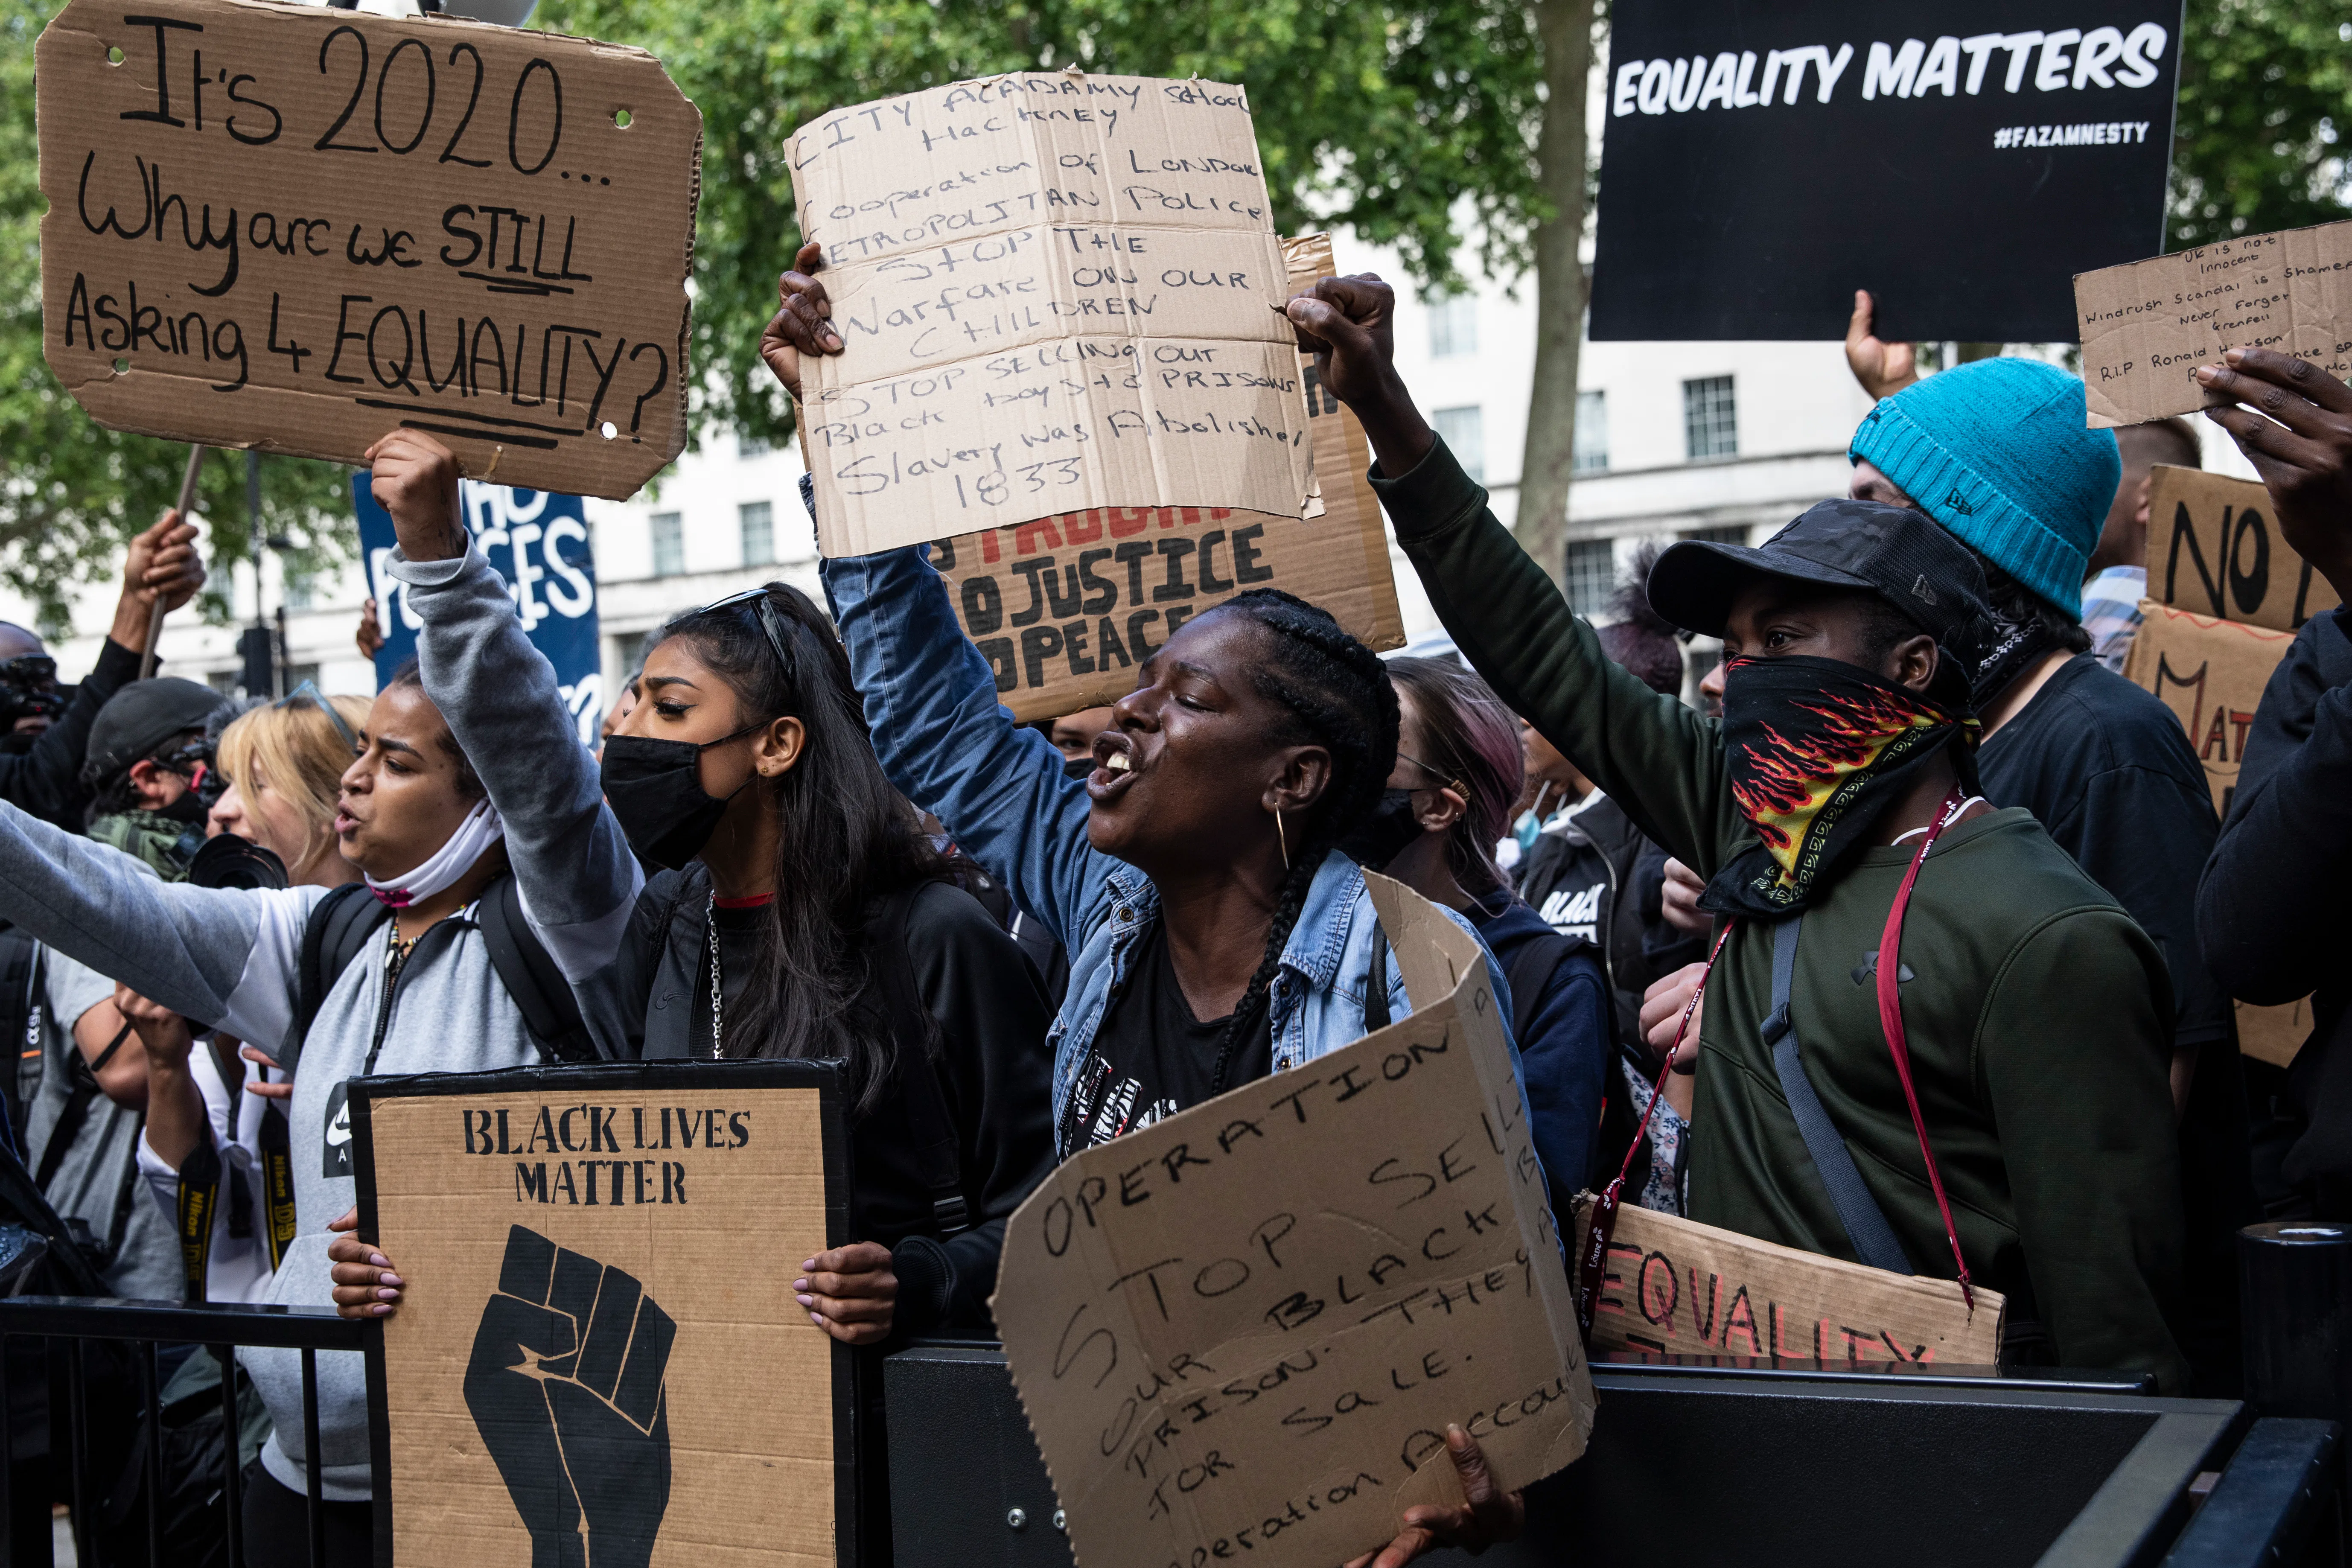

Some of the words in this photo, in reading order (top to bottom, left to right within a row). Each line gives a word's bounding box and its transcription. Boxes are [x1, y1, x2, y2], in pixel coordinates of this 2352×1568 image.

[1613, 42, 1854, 117] EQUALITY
[1861, 21, 2168, 101] MATTERS
[795, 101, 911, 171] CITY
[1994, 121, 2150, 149] #FAZAMNESTY
[78, 150, 238, 297] Why
[249, 212, 329, 256] are
[346, 223, 422, 268] we
[440, 204, 592, 282] STILL
[828, 188, 1100, 264] ETROPOLITAN
[1053, 228, 1145, 253] THE
[2244, 236, 2276, 249] not
[1073, 267, 1138, 287] ON
[1162, 269, 1250, 289] OUR
[2200, 254, 2259, 274] Innocent
[2086, 300, 2162, 324] Windrush
[2174, 283, 2240, 304] Scandal
[2253, 276, 2268, 285] is
[2180, 309, 2219, 325] Never
[65, 272, 249, 392] Asking
[267, 292, 312, 373] 4
[325, 294, 668, 444] EQUALITY?
[2151, 347, 2206, 367] Ronald
[821, 369, 965, 419] STOP
[955, 456, 1081, 508] 1833
[1011, 523, 1274, 628] JUSTICE
[2165, 501, 2270, 618] NO
[462, 1103, 621, 1155] BLACK
[633, 1107, 751, 1151] LIVES
[1043, 1027, 1450, 1257] OPERATION
[516, 1160, 688, 1206] MATTER
[187, 1191, 204, 1237] Nikon
[1263, 1203, 1499, 1331] BLACK
[1588, 1242, 1602, 1268] Löwe
[1053, 1213, 1297, 1390] STOP
[1595, 1241, 1935, 1363] EQUALITY
